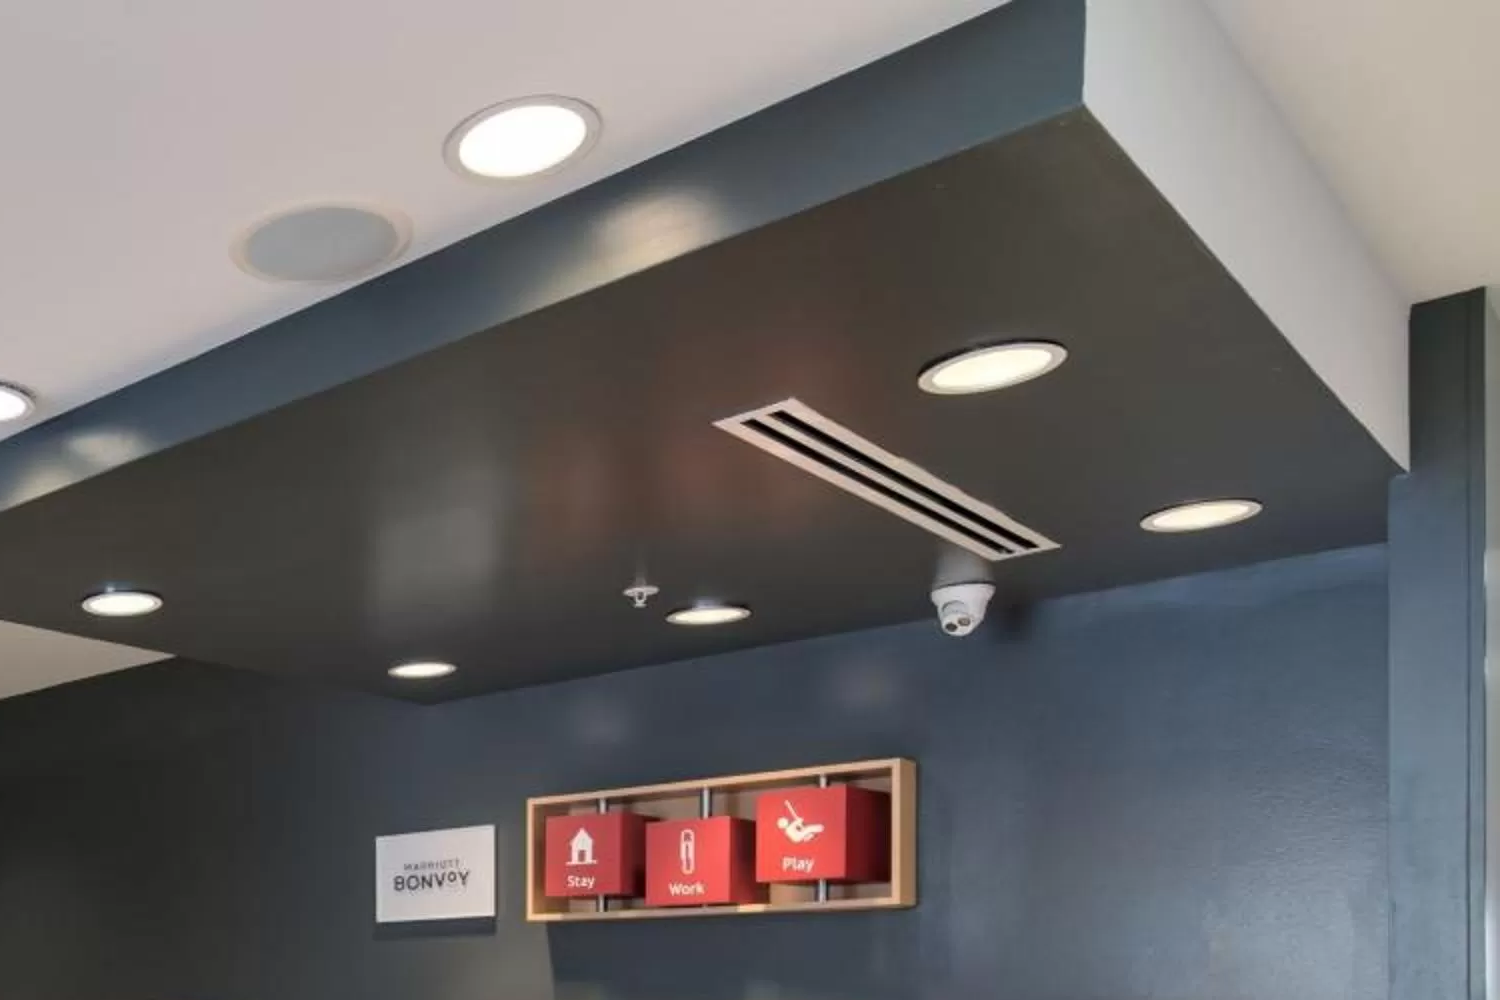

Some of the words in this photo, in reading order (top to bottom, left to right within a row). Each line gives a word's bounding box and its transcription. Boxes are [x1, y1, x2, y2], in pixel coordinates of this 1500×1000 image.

[782, 856, 814, 873] Play
[393, 870, 469, 892] BONVOY
[566, 875, 595, 889] Stay
[668, 882, 705, 896] Work
